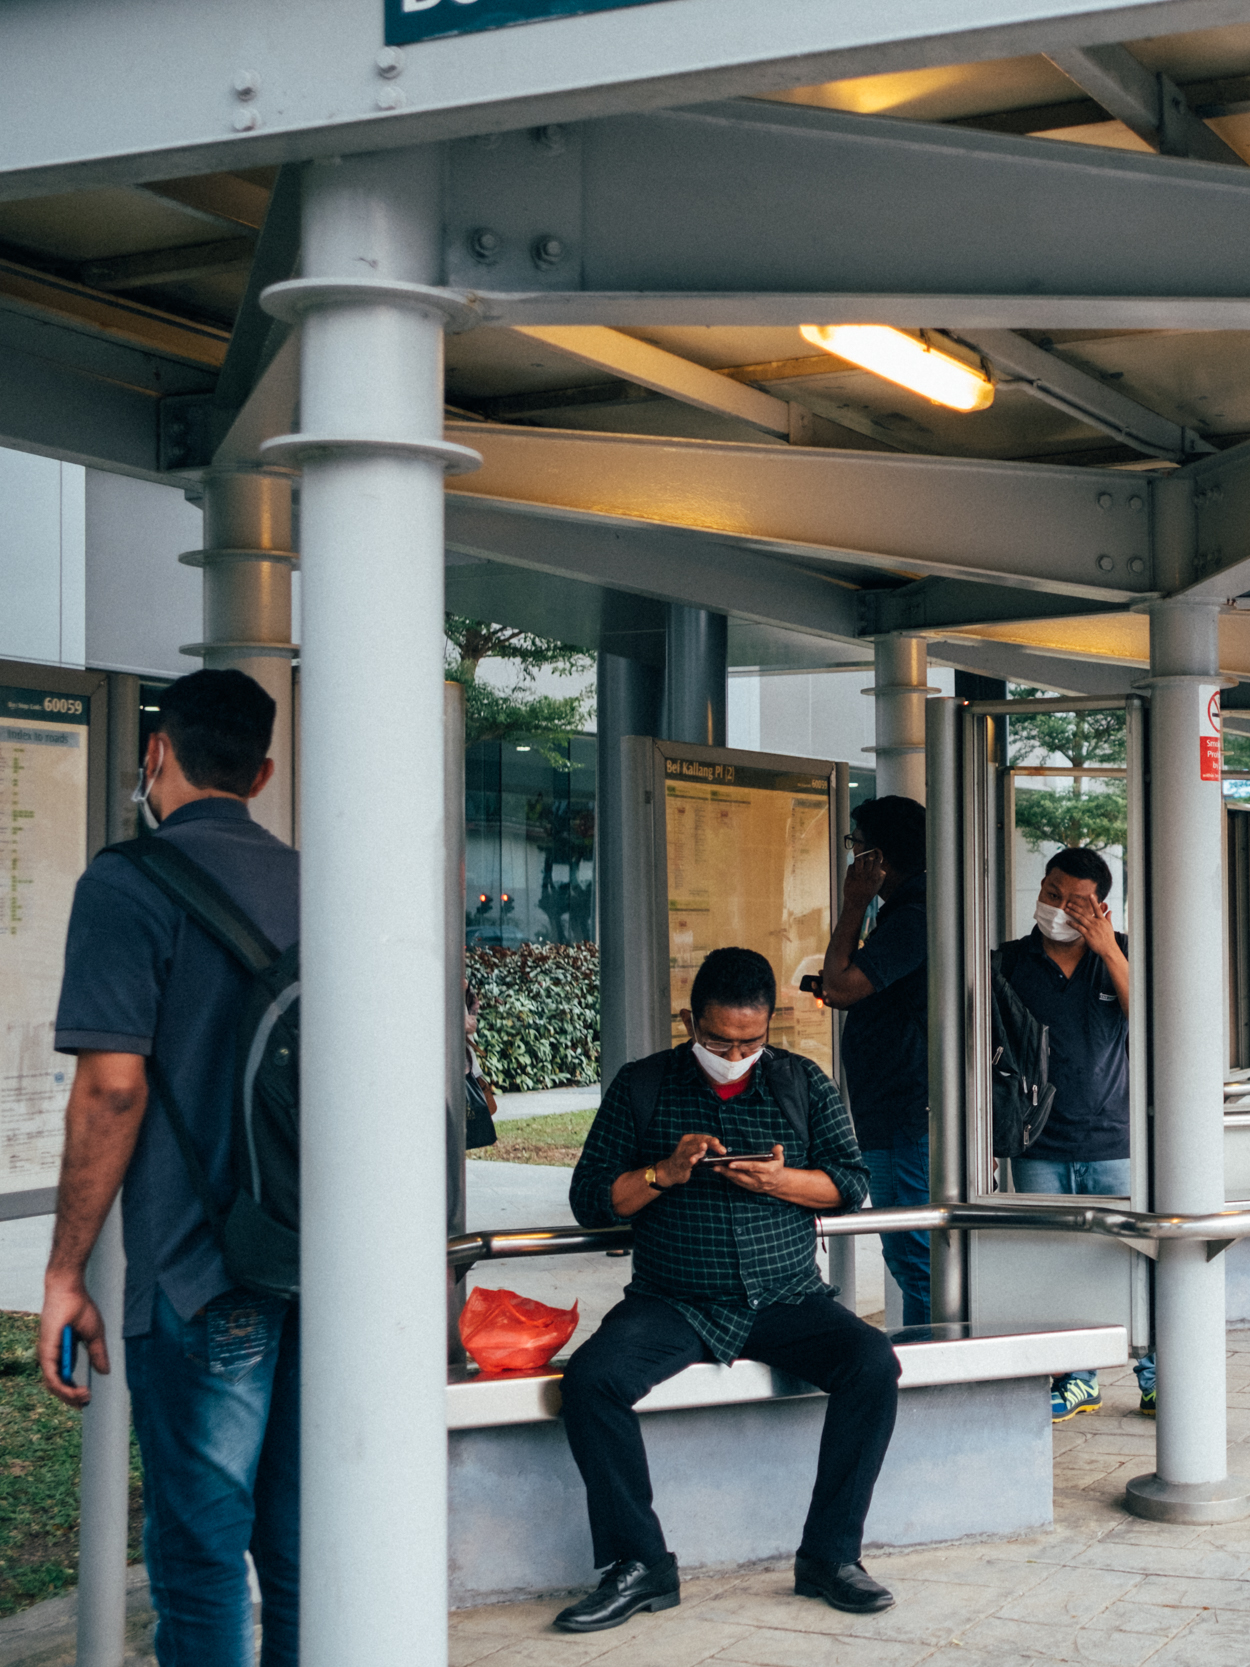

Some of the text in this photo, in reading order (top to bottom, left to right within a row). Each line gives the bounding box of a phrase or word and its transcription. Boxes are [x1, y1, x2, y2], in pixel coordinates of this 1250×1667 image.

[43, 697, 83, 715] 60059
[7, 729, 69, 744] Index to roads
[666, 760, 735, 783] Bef Kallang Pl (2)
[811, 778, 828, 790] 60059
